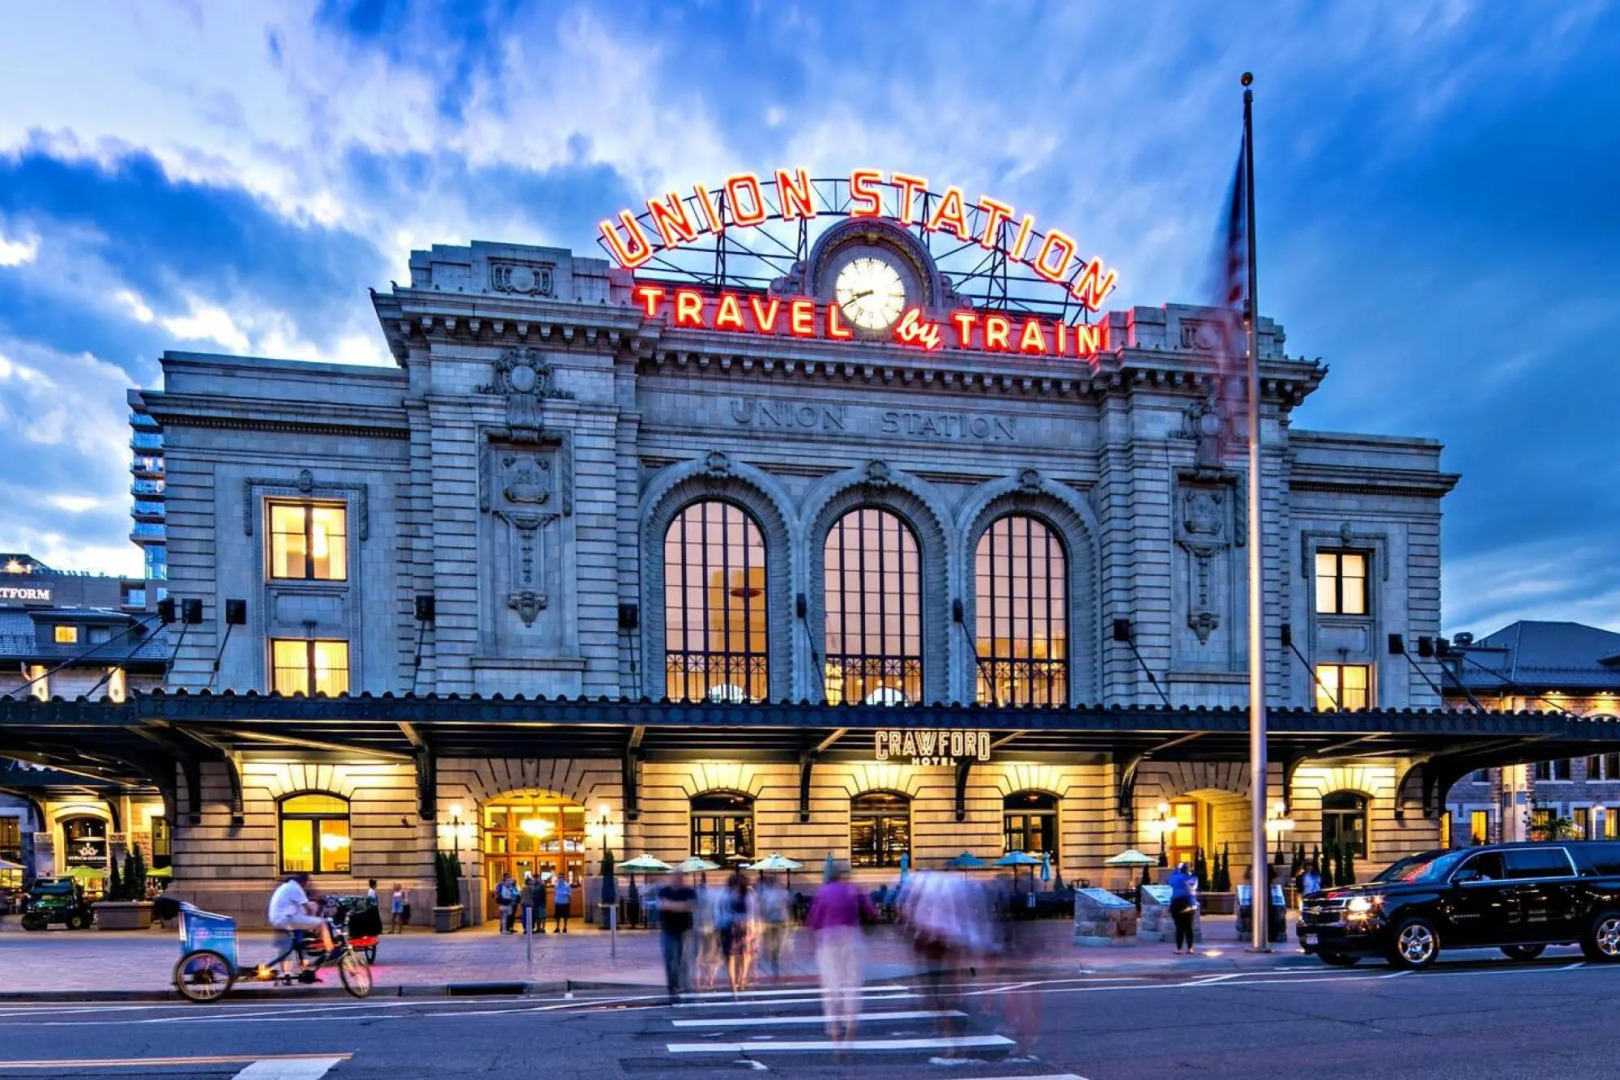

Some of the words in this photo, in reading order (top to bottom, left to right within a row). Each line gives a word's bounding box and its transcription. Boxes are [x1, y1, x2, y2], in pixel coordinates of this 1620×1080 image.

[598, 166, 819, 270] UNION
[847, 168, 1118, 312] STATION
[636, 286, 855, 340] TRAVEL
[894, 307, 941, 352] by
[952, 311, 1104, 359] TRAIN
[731, 400, 847, 431] UNION
[880, 411, 1017, 441] STATION
[875, 730, 991, 761] CRAWFORD
[911, 757, 957, 766] HOTEL
